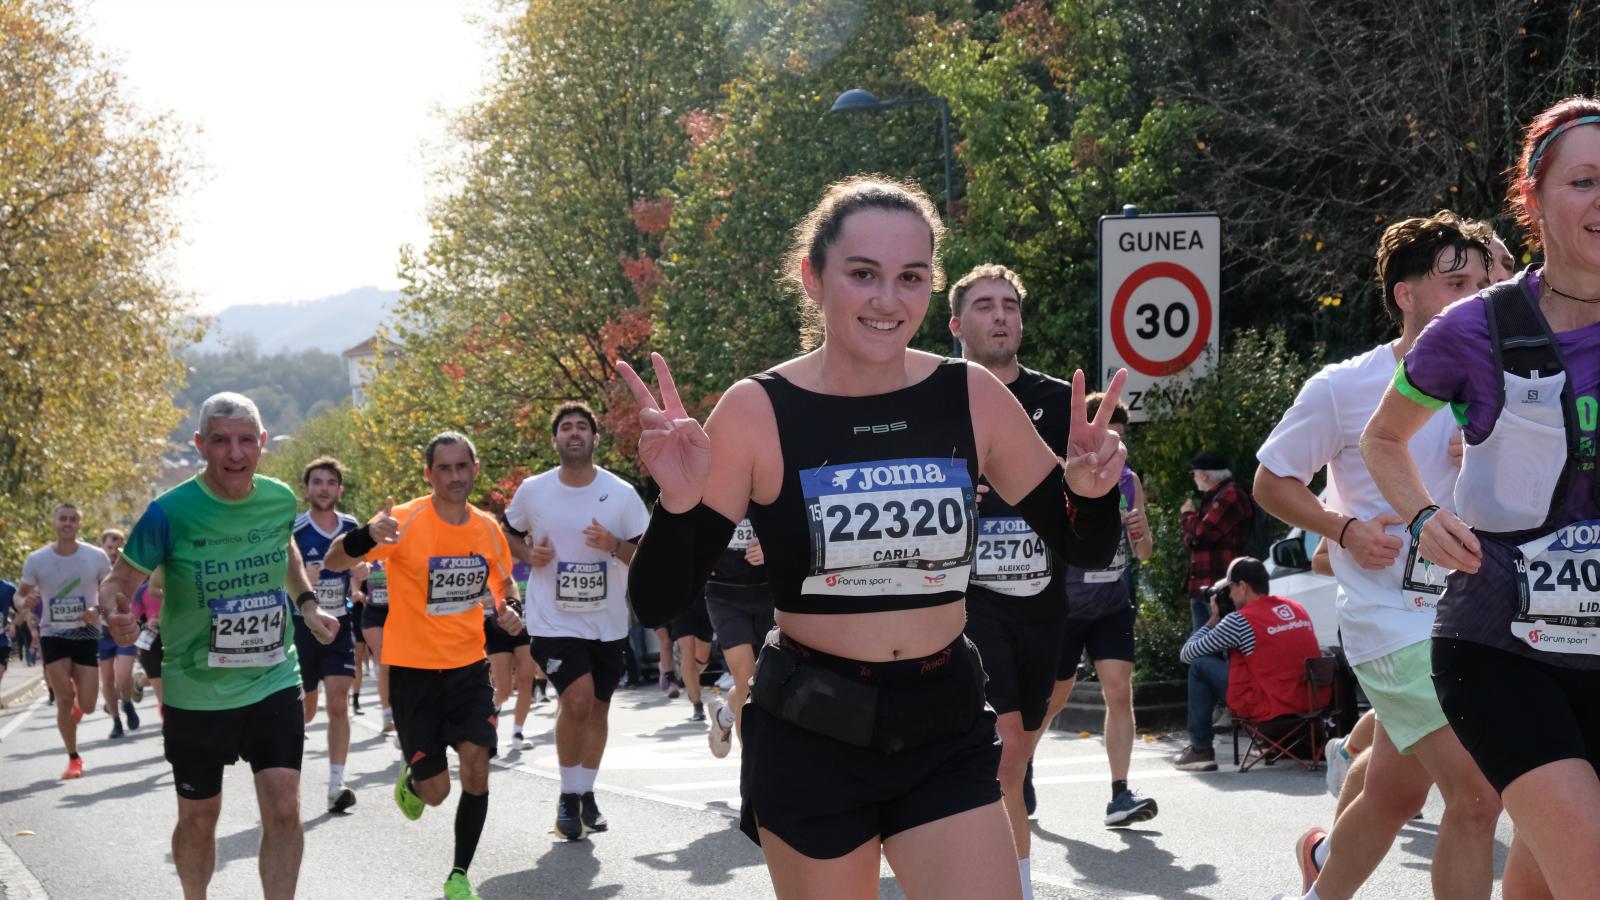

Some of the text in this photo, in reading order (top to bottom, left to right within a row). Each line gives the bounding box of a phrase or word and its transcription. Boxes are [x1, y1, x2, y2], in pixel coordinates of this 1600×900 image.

[1119, 230, 1204, 252] GUNEA
[1136, 302, 1190, 340] 30
[853, 421, 908, 435] PBS
[826, 497, 963, 542] 22320
[996, 519, 1030, 534] Jom
[873, 548, 921, 562] CARLA
[978, 537, 1045, 560] 25704
[205, 547, 287, 576] En march
[206, 571, 269, 592] contra
[435, 571, 485, 588] 24695
[561, 575, 603, 589] 21954
[1529, 559, 1600, 592] 240
[1579, 602, 1600, 612] LID
[219, 612, 281, 636] 24214
